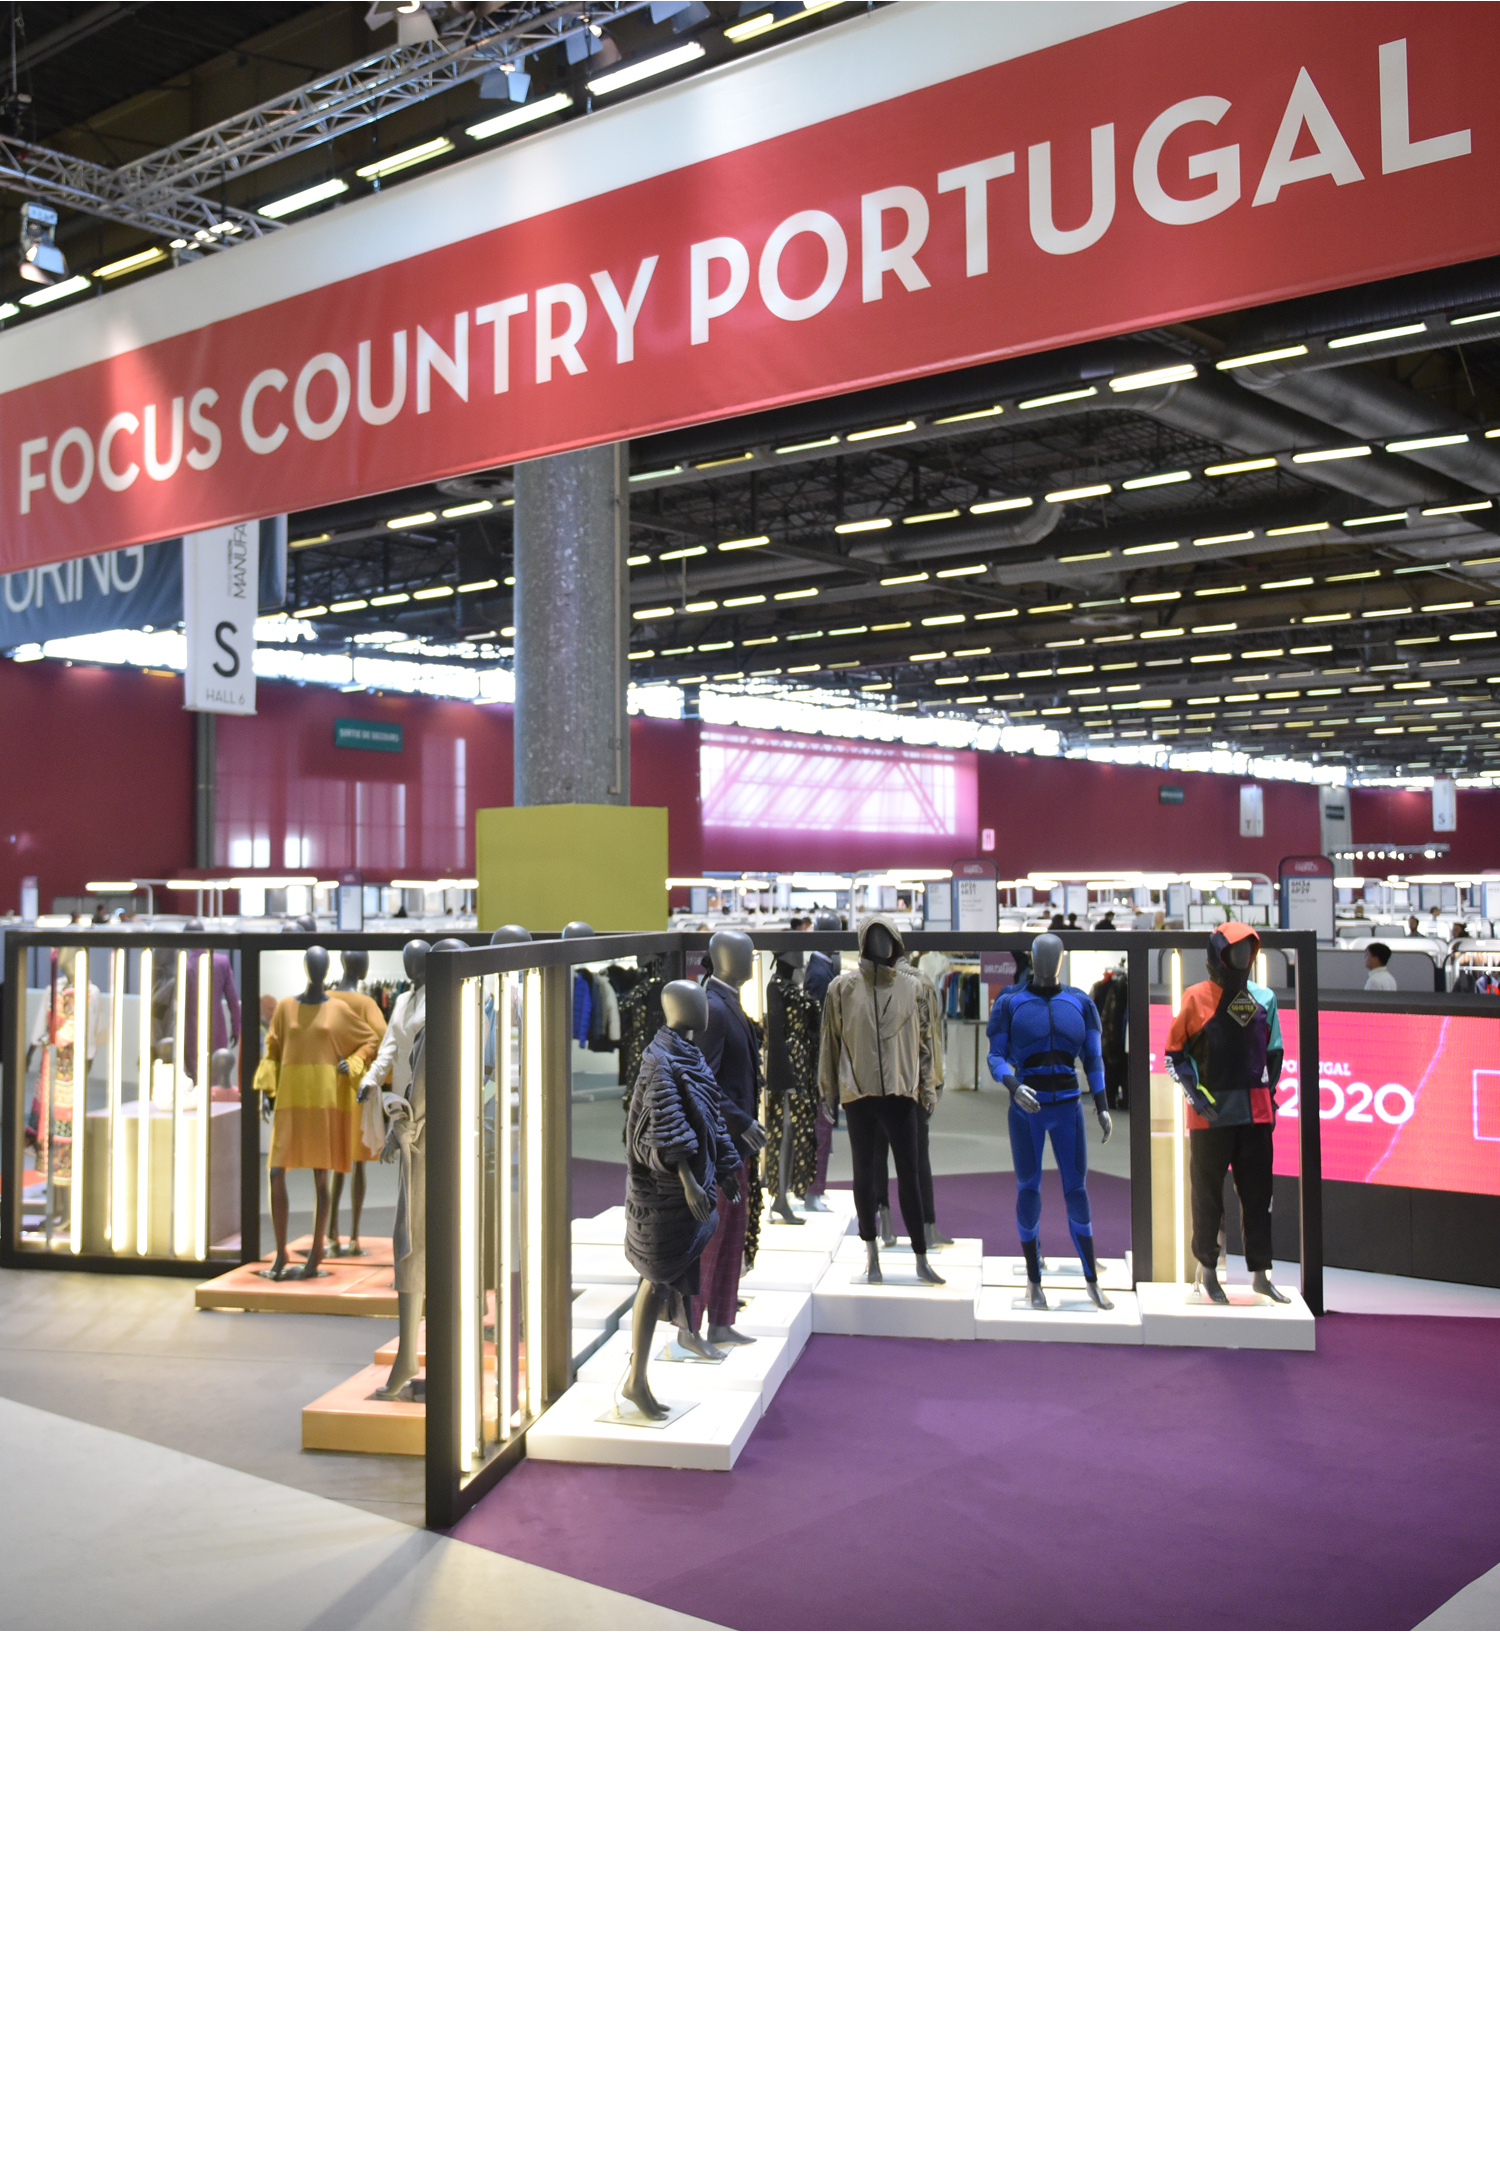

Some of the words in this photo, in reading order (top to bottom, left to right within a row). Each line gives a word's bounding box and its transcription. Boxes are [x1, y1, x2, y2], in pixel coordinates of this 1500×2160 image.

[20, 387, 222, 516] FOCUS
[240, 255, 660, 455] COUNTRY
[690, 37, 1472, 346] PORTUGAL
[212, 621, 240, 678] S
[205, 688, 235, 705] HALL
[238, 694, 245, 706] 6
[1245, 819, 1252, 831] T
[1277, 1077, 1415, 1125] 2020
